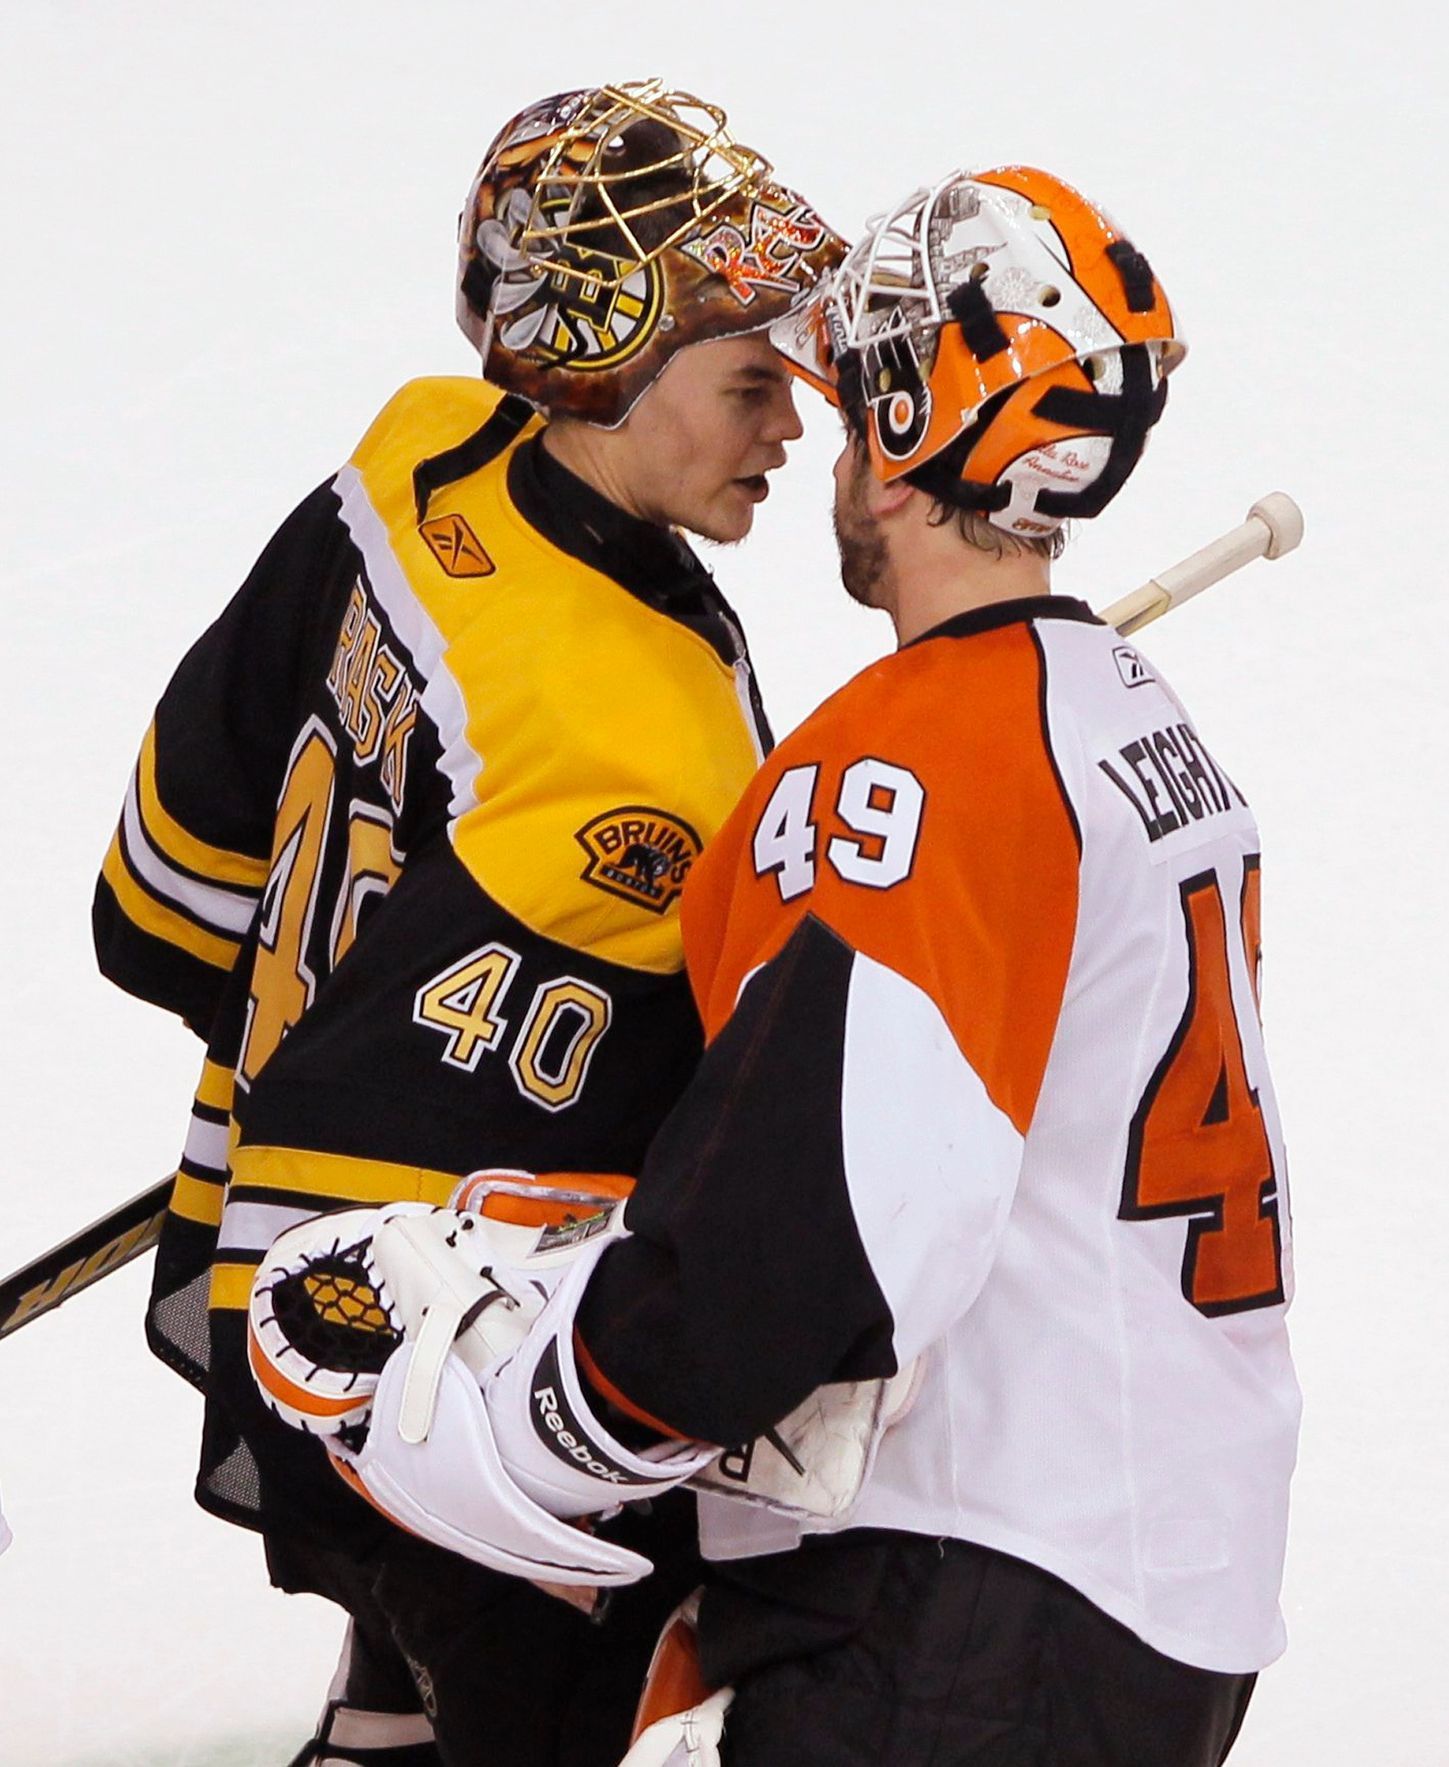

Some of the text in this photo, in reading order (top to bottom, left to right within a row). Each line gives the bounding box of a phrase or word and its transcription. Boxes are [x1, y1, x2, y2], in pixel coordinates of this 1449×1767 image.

[326, 574, 418, 818] RASK
[593, 820, 694, 884] BRUINS
[752, 754, 927, 905] 49
[412, 941, 613, 1113] 40
[1116, 852, 1264, 1319] 4
[534, 1386, 629, 1484] Reebok
